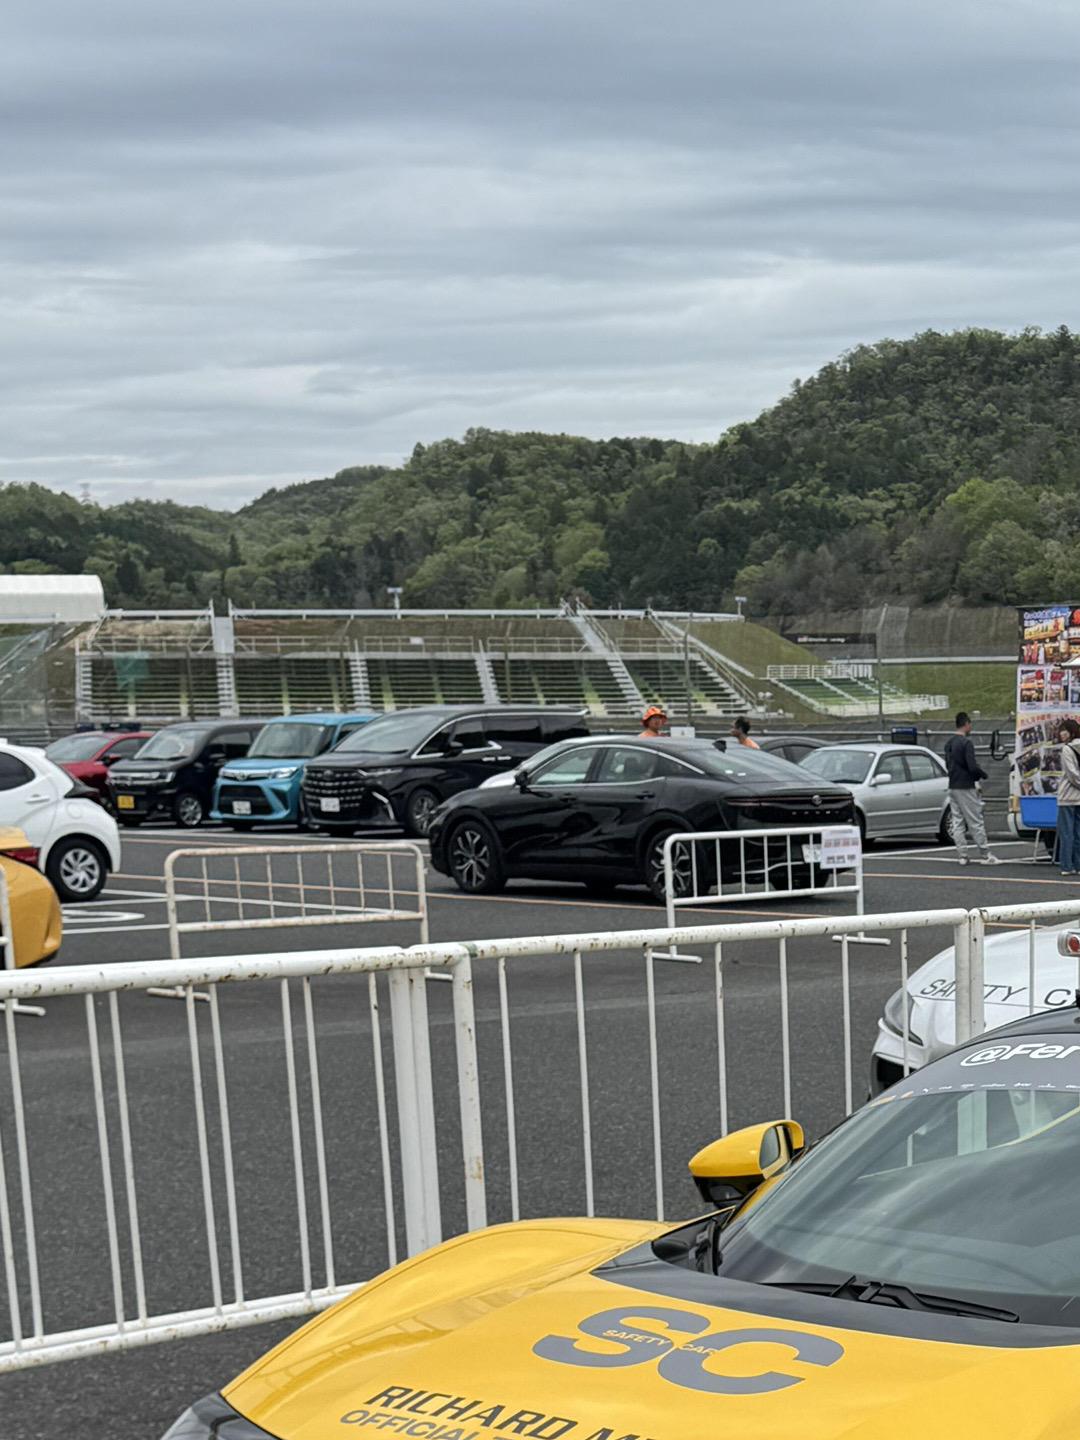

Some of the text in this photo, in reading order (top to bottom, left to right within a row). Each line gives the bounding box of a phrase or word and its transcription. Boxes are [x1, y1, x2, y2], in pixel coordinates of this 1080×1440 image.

[921, 978, 1028, 1002] SATY
[602, 1328, 673, 1346] SAFETY
[532, 1306, 845, 1395] SC
